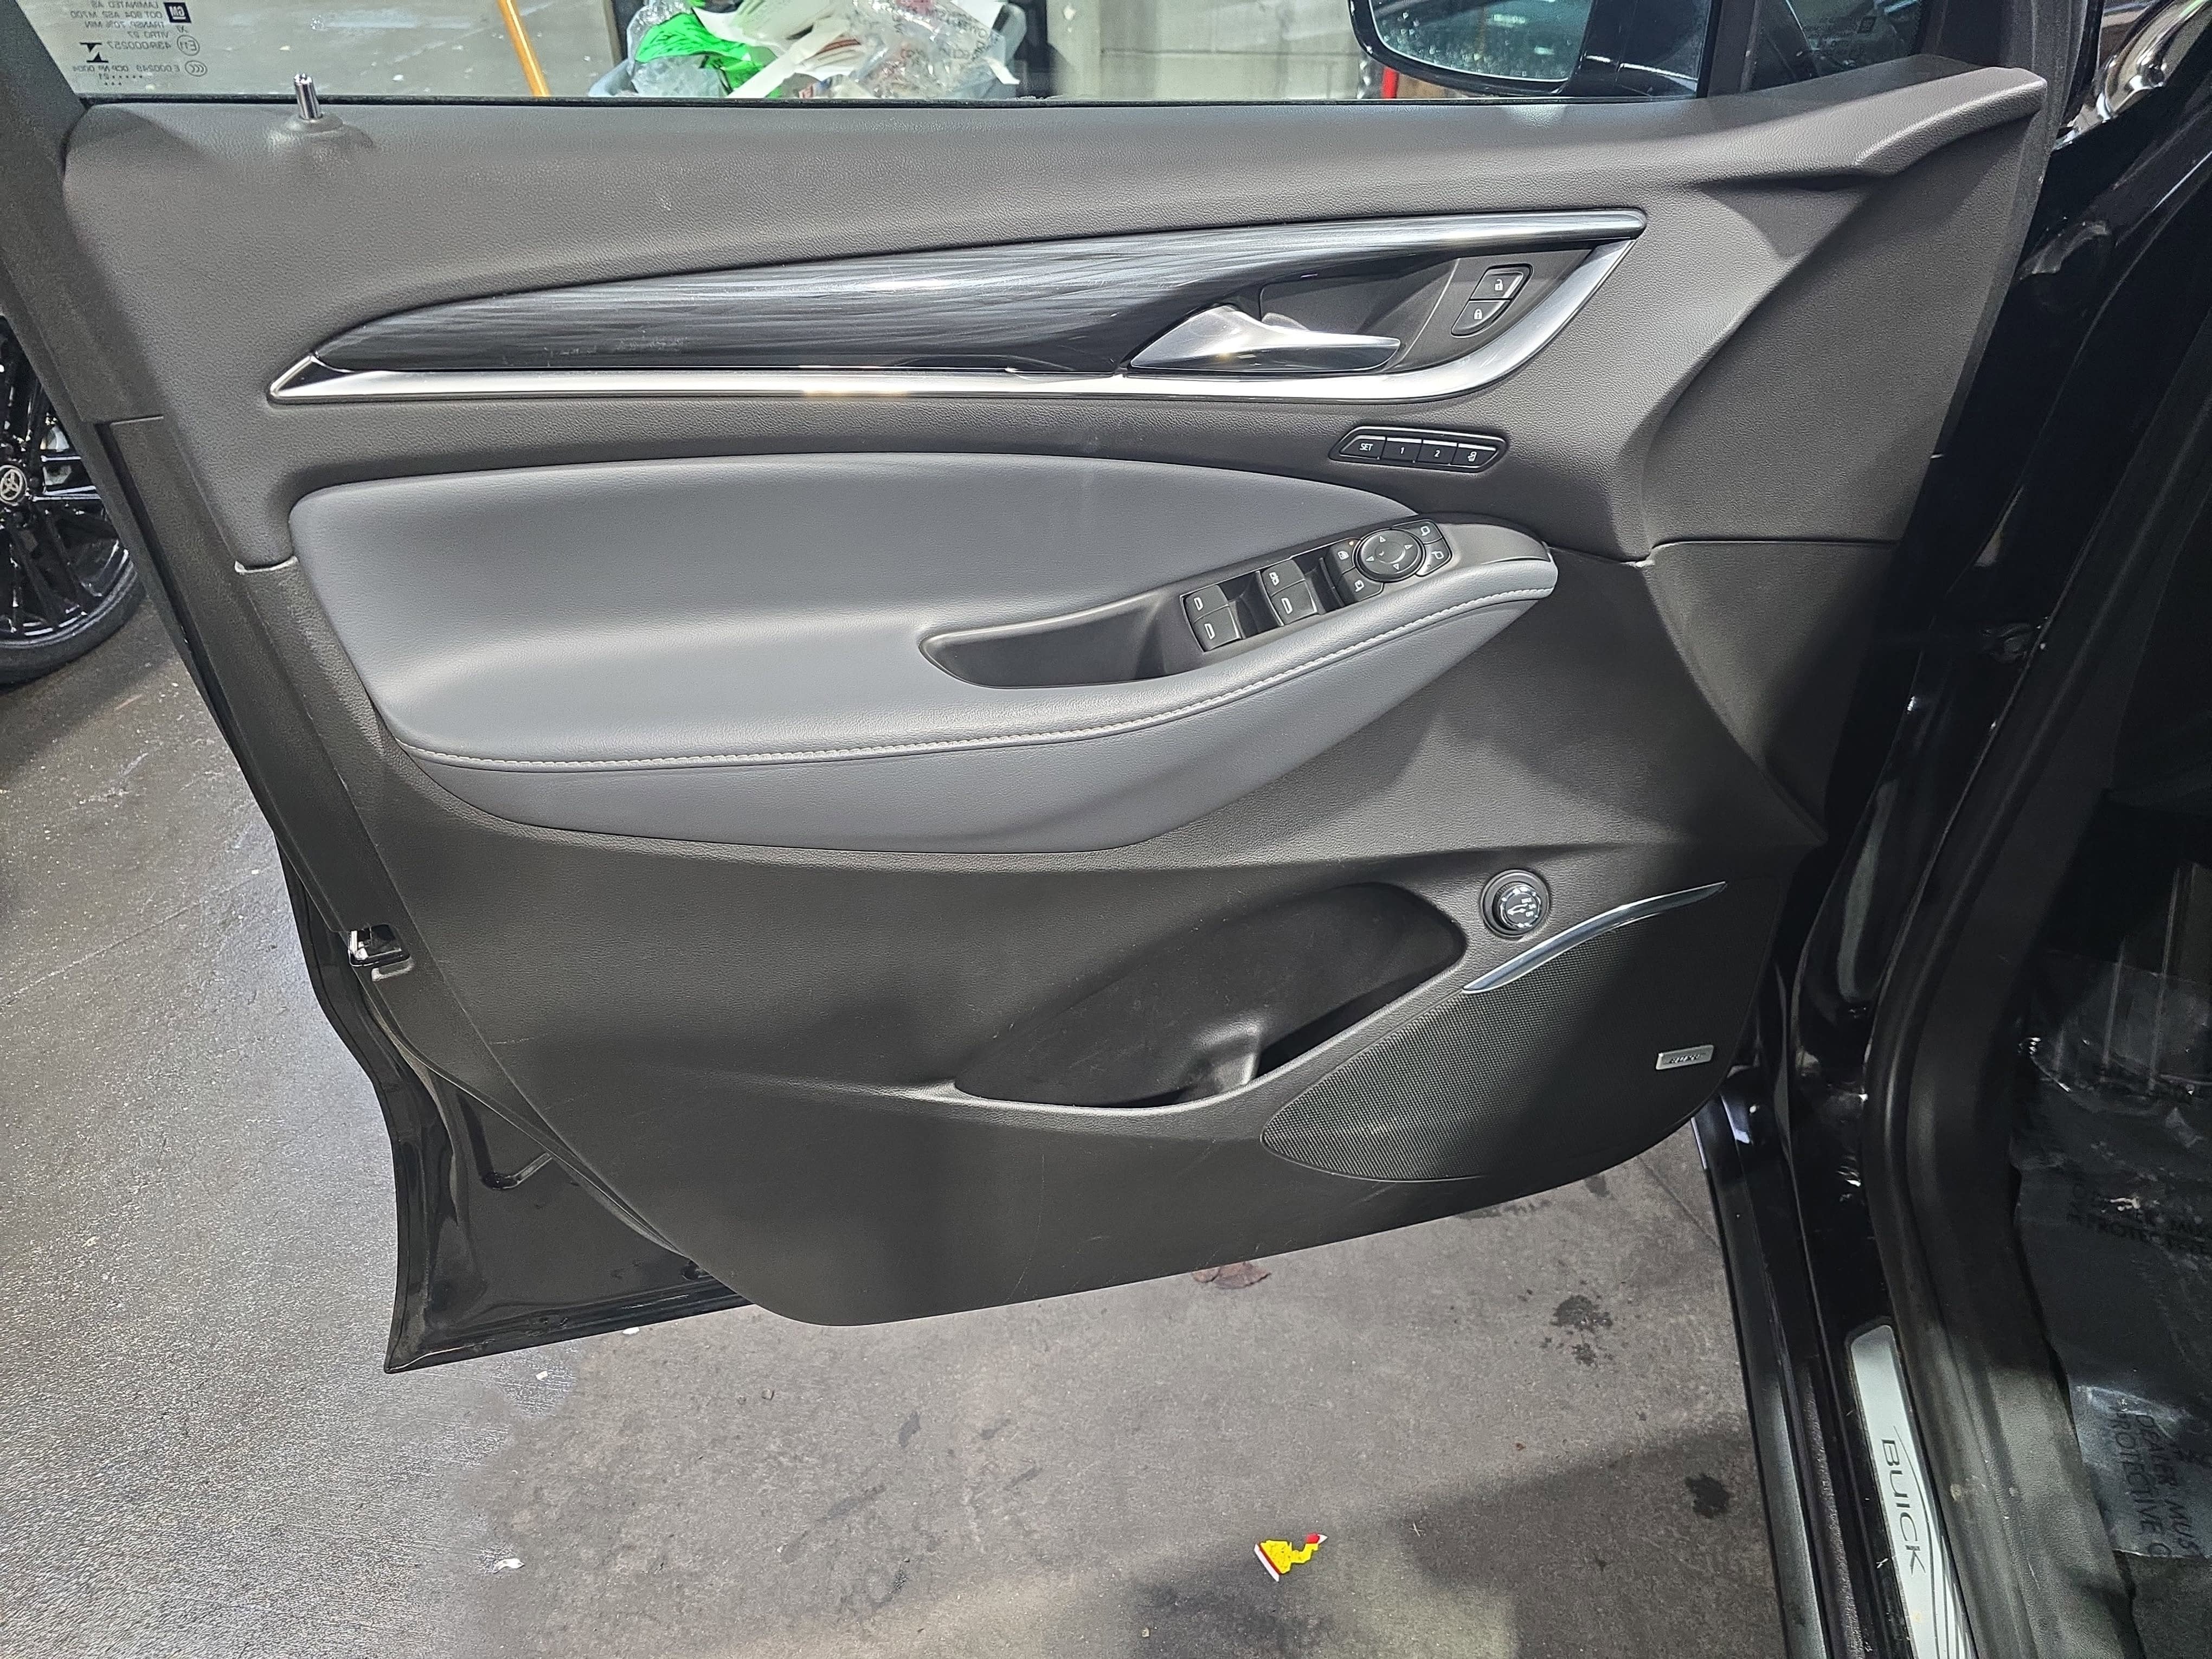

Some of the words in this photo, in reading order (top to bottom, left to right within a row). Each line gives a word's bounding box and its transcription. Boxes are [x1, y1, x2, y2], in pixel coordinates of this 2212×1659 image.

[1359, 442, 1373, 452] SET
[1434, 449, 1441, 458] 2
[1881, 1439, 1926, 1576] BUICK
